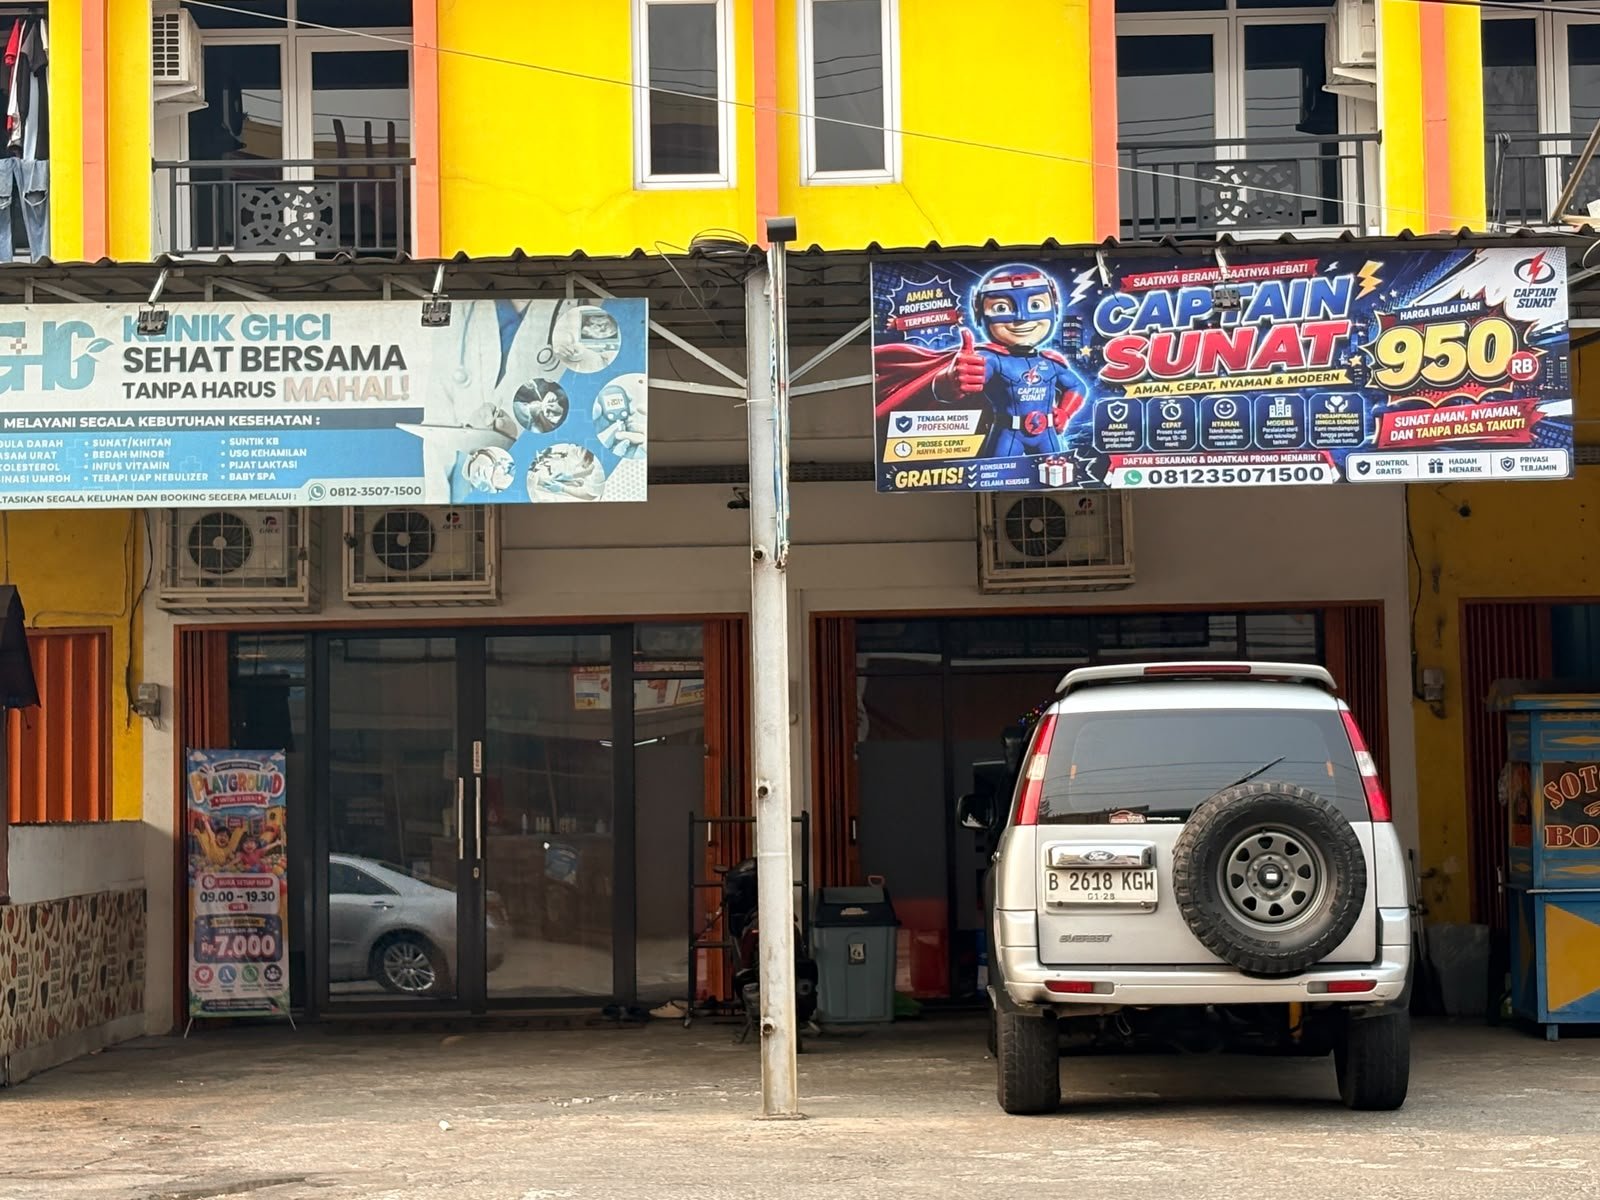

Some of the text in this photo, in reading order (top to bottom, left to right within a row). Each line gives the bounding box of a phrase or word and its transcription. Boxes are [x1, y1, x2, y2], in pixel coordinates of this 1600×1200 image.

[1133, 263, 1308, 288] SAATNYA BERANI, SAATNYA HEBAT!
[906, 288, 944, 303] AMAN &
[1513, 287, 1558, 298] CAPTAIN
[899, 298, 953, 315] PROFESIONAL
[1094, 275, 1355, 337] CAPTAIN
[1516, 298, 1556, 309] SUNAT
[1400, 302, 1481, 321] HARGA MULAI DARI
[241, 313, 331, 342] GHCI
[1099, 320, 1352, 383] SUNAT
[1376, 319, 1515, 387] 950
[124, 345, 408, 374] SEHAT BERSAMA
[1511, 358, 1534, 374] RB
[122, 375, 410, 403] TANPA HARUS MAHAL!
[1133, 373, 1340, 395] AMAN, CEPAT, NYAMAN & MODERN
[1017, 387, 1047, 395] CAPTAIN
[1020, 394, 1046, 402] SUNAT
[4, 415, 313, 429] MELAYANI SEGALA KEBUTUHAN KESEHATAN
[1394, 406, 1521, 428] SUNAT AMAN, NYAMAN,
[916, 422, 970, 431] PROFESIONAL
[1390, 418, 1525, 442] DAN TANPA RASA TAKUT!
[27, 439, 63, 448] DARAH
[92, 438, 171, 448] SUNAT/KHITAN
[229, 437, 280, 447] SUNTIK KB
[916, 439, 965, 448] PROSES CEPAT
[30, 451, 57, 460] URAT
[92, 450, 165, 459] BEDAH MINOR
[229, 448, 307, 458] USG KEHAMILAN
[1122, 457, 1153, 466] DAFTAR
[1154, 456, 1198, 465] SEKARANG
[1199, 456, 1205, 464] &
[1206, 455, 1249, 464] DAPATKAN
[1250, 454, 1279, 463] PROMO
[1280, 453, 1316, 462] MENARIK
[92, 461, 170, 471] INFUS VITAMIN
[229, 461, 298, 471] PIJAT LAKTASI
[1520, 464, 1557, 472] TERJAMIN
[32, 474, 71, 483] UMROH
[92, 473, 208, 483] TERAPI UAP NEBULIZER
[229, 473, 276, 482] BABY SPA
[895, 466, 964, 489] GRATIS!
[1148, 467, 1324, 485] 081235071500
[329, 486, 422, 497] 0812-3507-1500
[46, 495, 85, 503] SEGALA
[87, 494, 135, 503] KELUHAN
[136, 494, 158, 502] DAN
[160, 493, 207, 502] BOOKING
[208, 493, 247, 502] SEGERA
[249, 492, 292, 501] MELALUI
[190, 771, 284, 802] PLAYGROUND
[1049, 871, 1154, 891] B 2618 KGW
[200, 892, 234, 902] 09.00
[245, 891, 275, 902] 19.30
